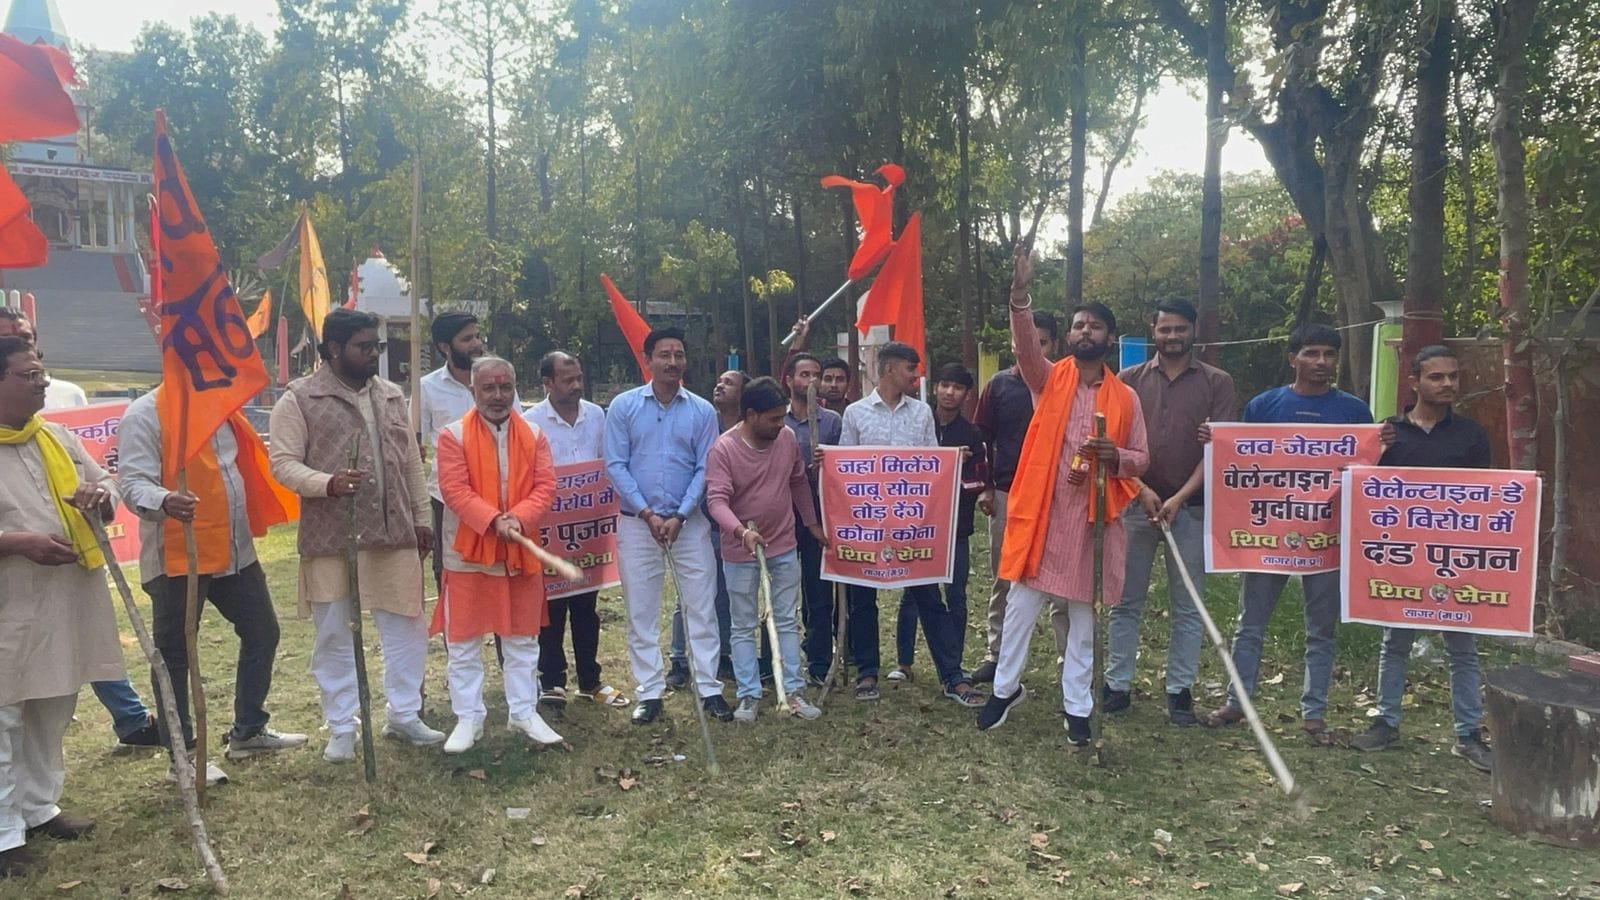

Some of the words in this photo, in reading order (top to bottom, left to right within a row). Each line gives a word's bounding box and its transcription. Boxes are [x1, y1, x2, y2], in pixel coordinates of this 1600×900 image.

[1236, 435, 1356, 456] लव-जेहादी
[837, 455, 876, 474] जहां
[881, 455, 940, 473] मिलेंगे
[1224, 464, 1342, 492] वेलेन्टाइन-
[847, 483, 882, 500] बाबू
[885, 479, 930, 496] सोना
[1363, 477, 1524, 504] वेलेन्टाइन-डे
[852, 502, 887, 521] तोड़
[893, 501, 924, 519] देंगे
[1250, 495, 1333, 525] मुर्दाबाद
[1371, 506, 1400, 527] के
[1407, 506, 1480, 531] विरोध
[1488, 510, 1515, 532] में
[557, 515, 618, 550] पूजन
[837, 524, 884, 541] कोना
[892, 525, 935, 540] कोना
[1230, 529, 1279, 549] शिव
[1306, 532, 1340, 549] सेन
[837, 545, 877, 563] शिव
[896, 546, 933, 562] सेना
[1263, 556, 1291, 565] सागर
[1362, 533, 1416, 565] दंड
[1425, 544, 1520, 577] पूजन
[1369, 579, 1424, 600] शिव
[1454, 585, 1510, 605] सेना
[1404, 609, 1434, 618] सागर
